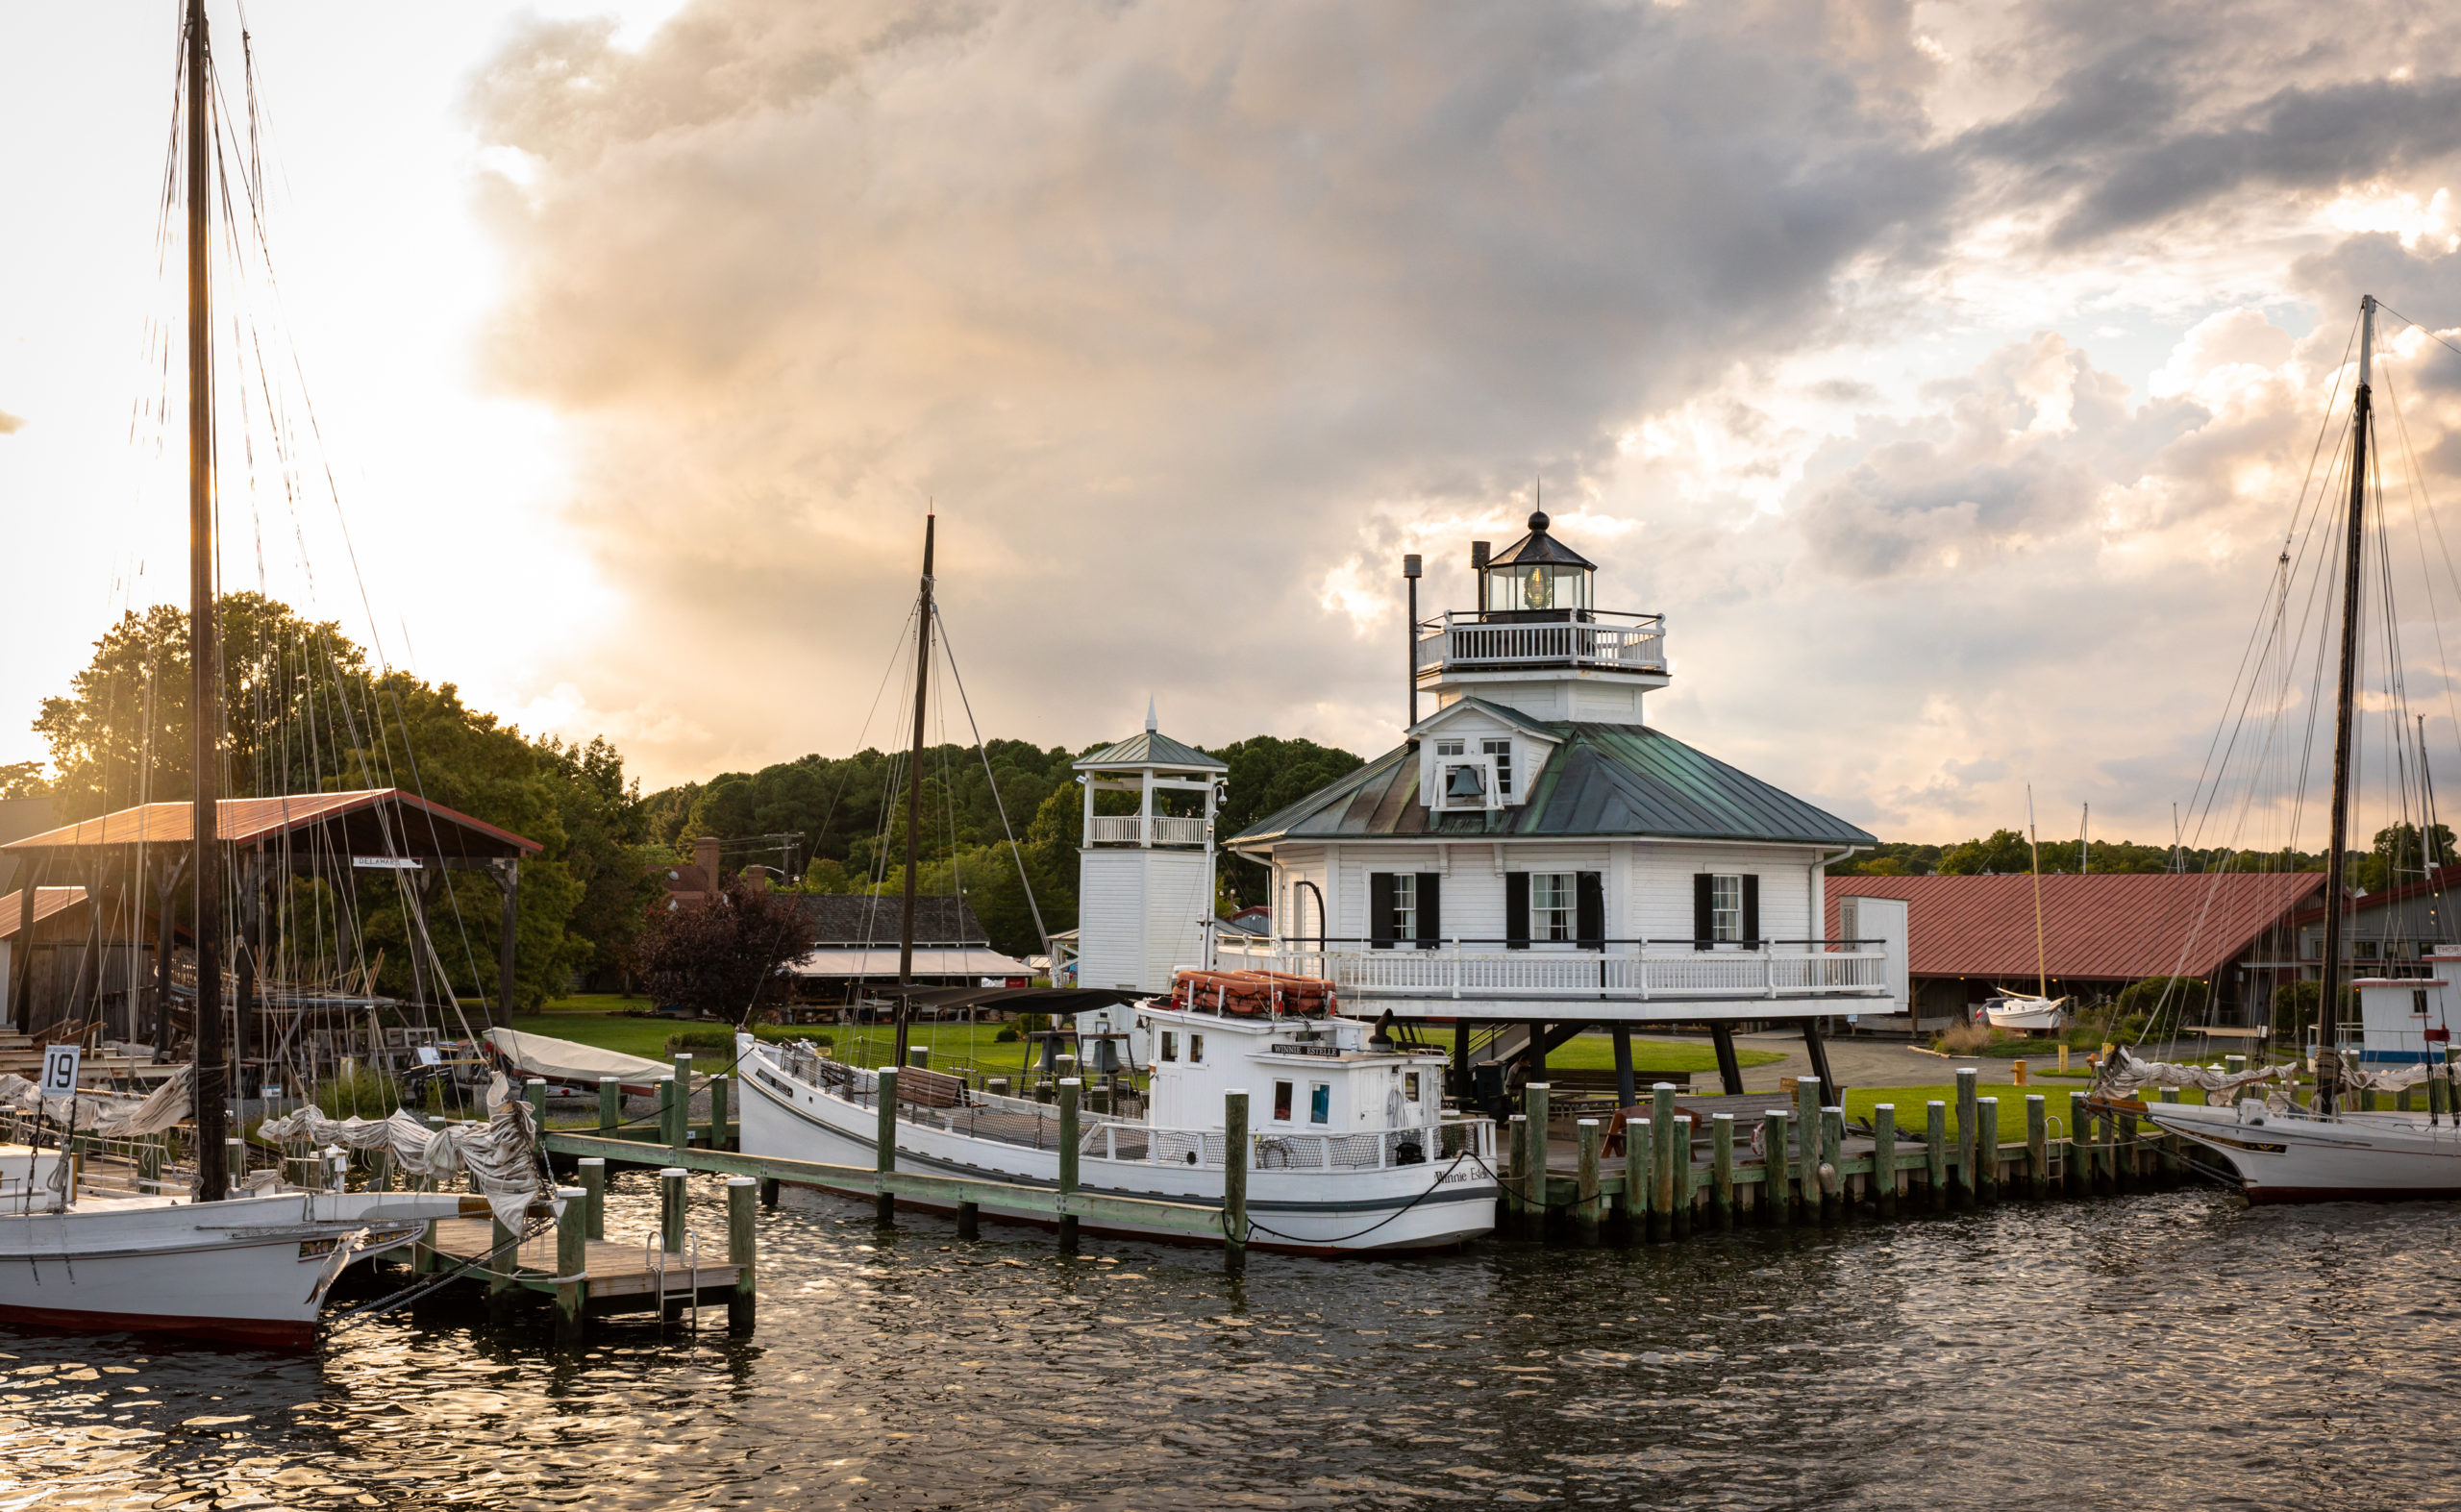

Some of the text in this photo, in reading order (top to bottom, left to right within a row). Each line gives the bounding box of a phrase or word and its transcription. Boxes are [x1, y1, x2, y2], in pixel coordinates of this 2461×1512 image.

[1275, 1045, 1337, 1056] WINNIE ESTELLE
[47, 1053, 73, 1088] 19
